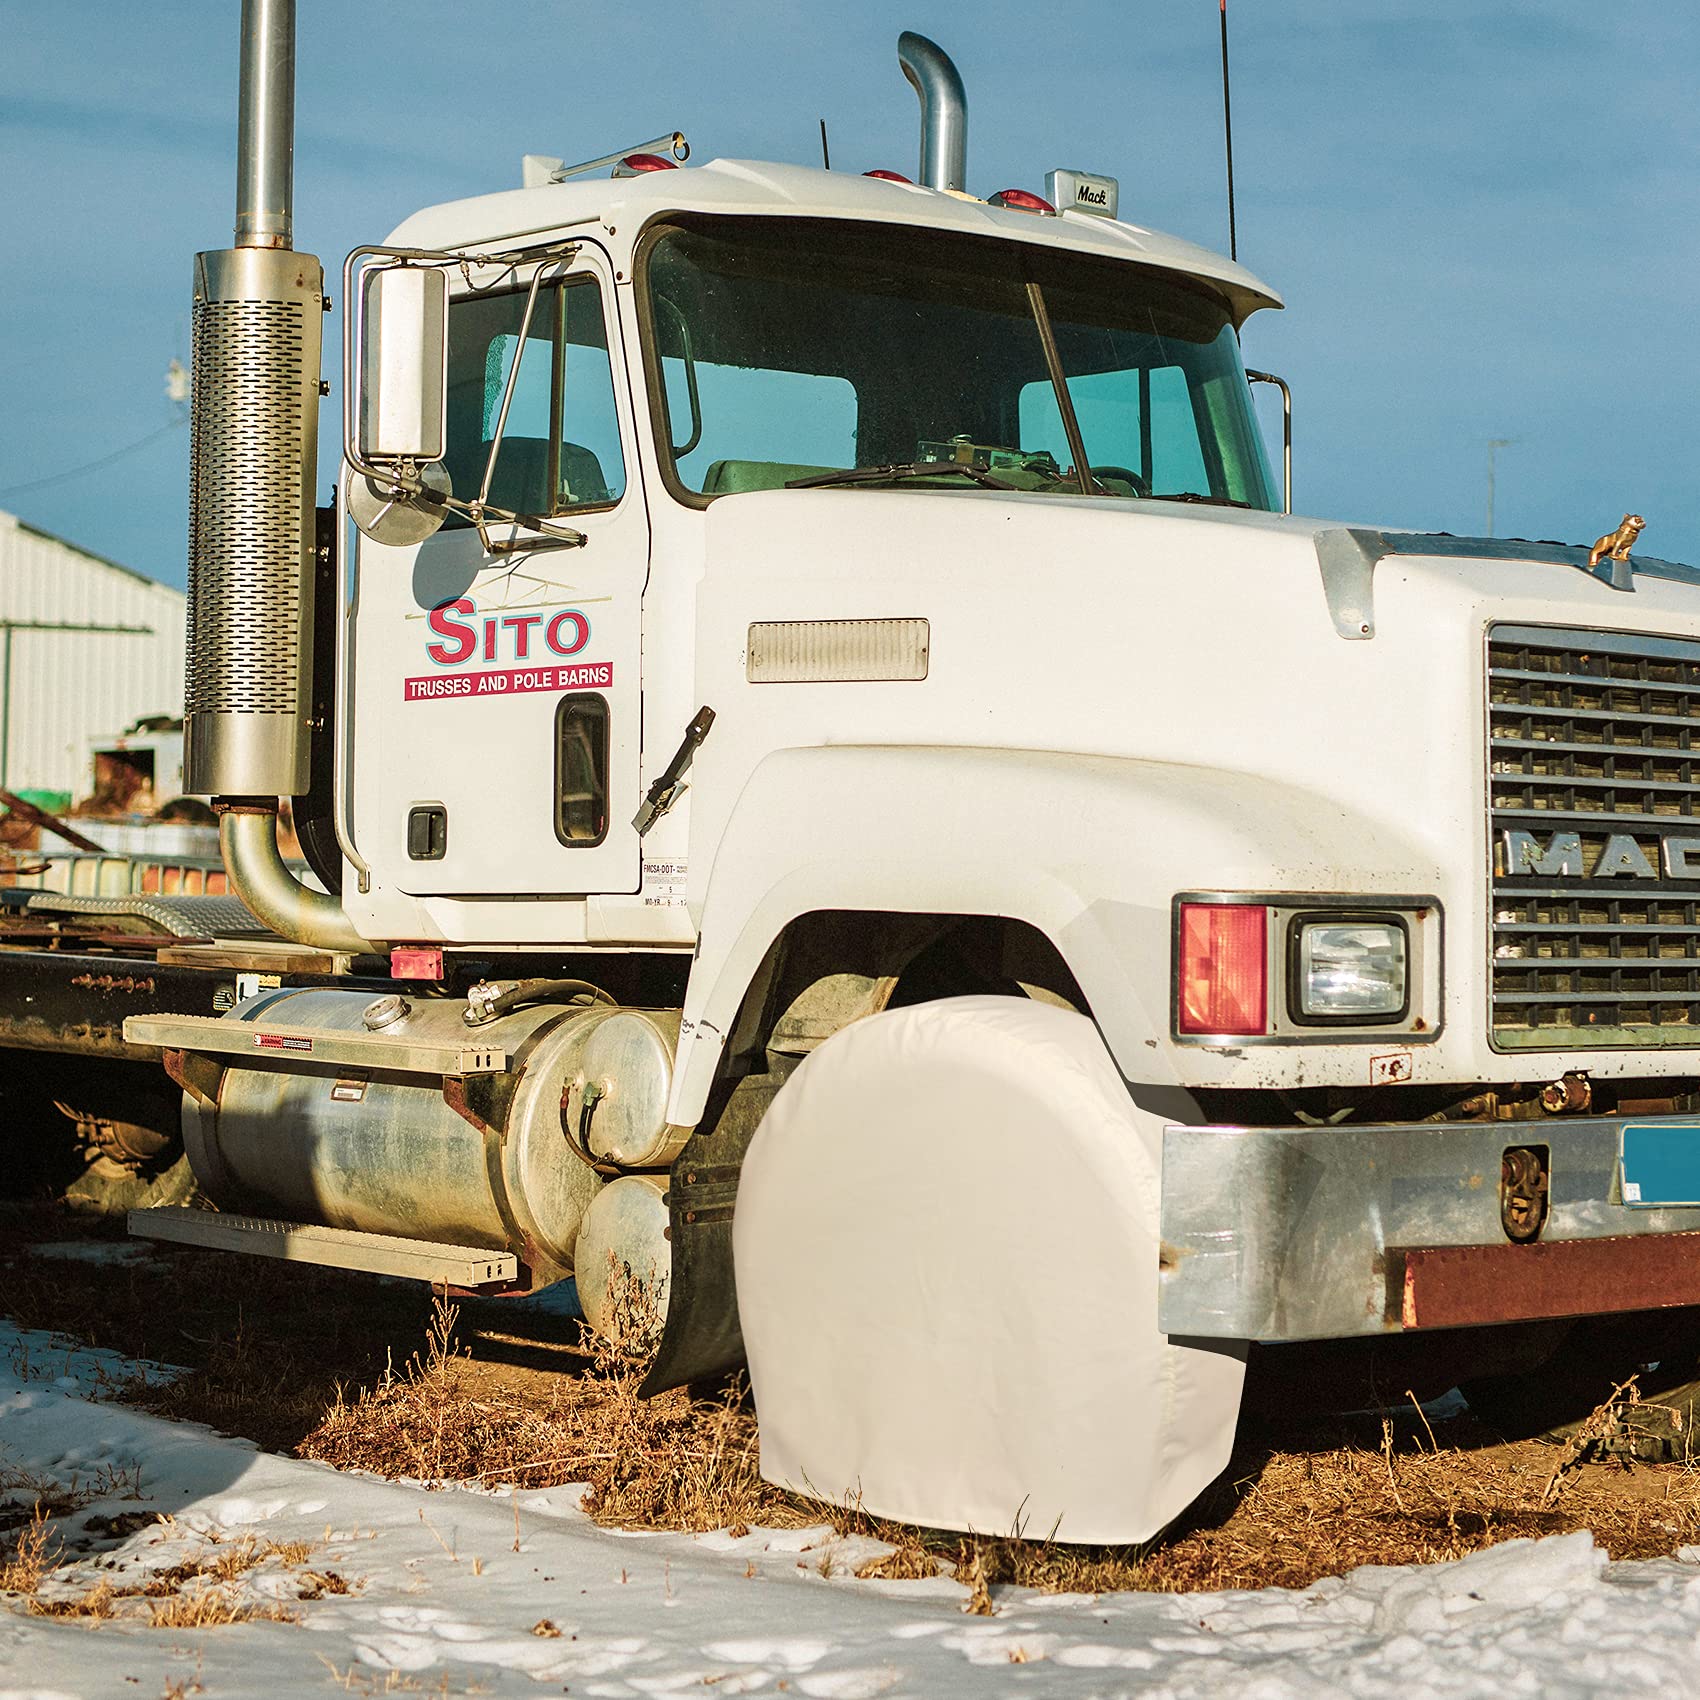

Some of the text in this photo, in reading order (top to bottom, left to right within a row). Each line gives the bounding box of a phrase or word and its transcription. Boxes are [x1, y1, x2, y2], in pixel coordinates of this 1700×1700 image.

[1078, 186, 1106, 205] Mack
[409, 666, 609, 697] TRUSSES AND POLE BARNS
